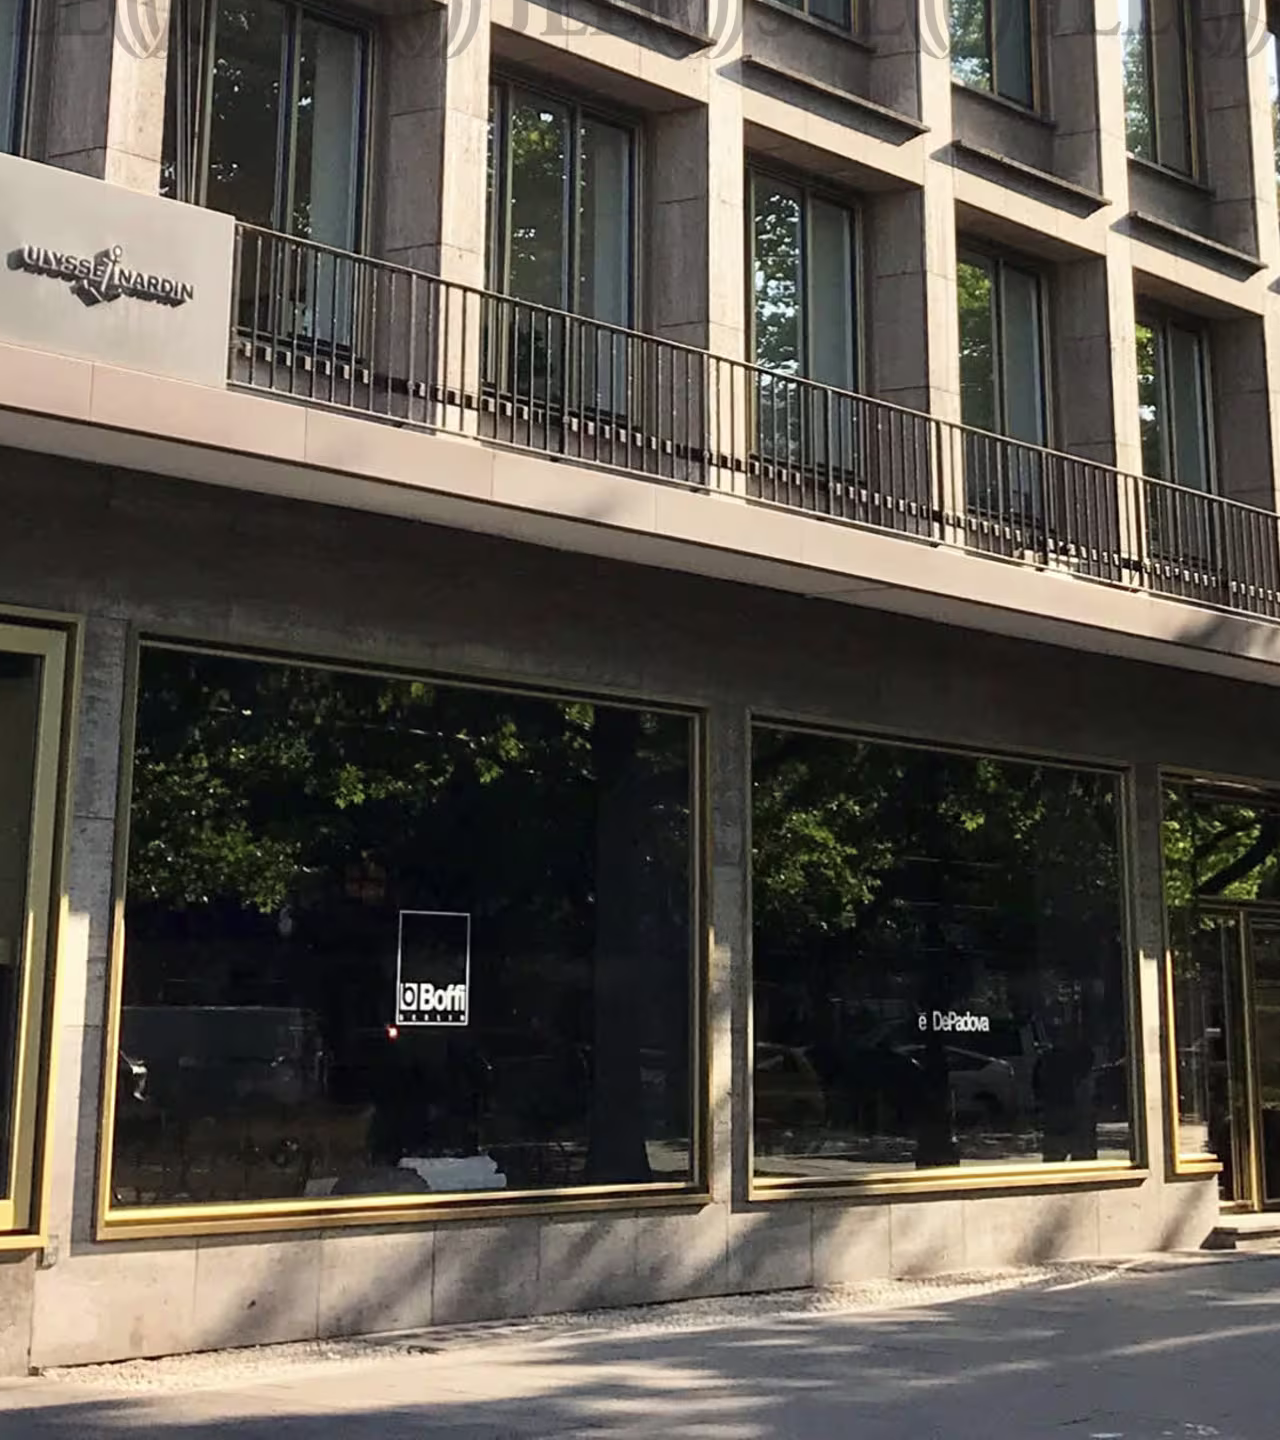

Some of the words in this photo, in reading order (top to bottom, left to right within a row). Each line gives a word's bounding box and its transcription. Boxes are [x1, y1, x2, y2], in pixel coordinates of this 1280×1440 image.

[23, 244, 105, 282] ULYSSE
[116, 267, 196, 301] NARDIN
[419, 982, 465, 1012] Boffi
[932, 1010, 990, 1032] DePadova
